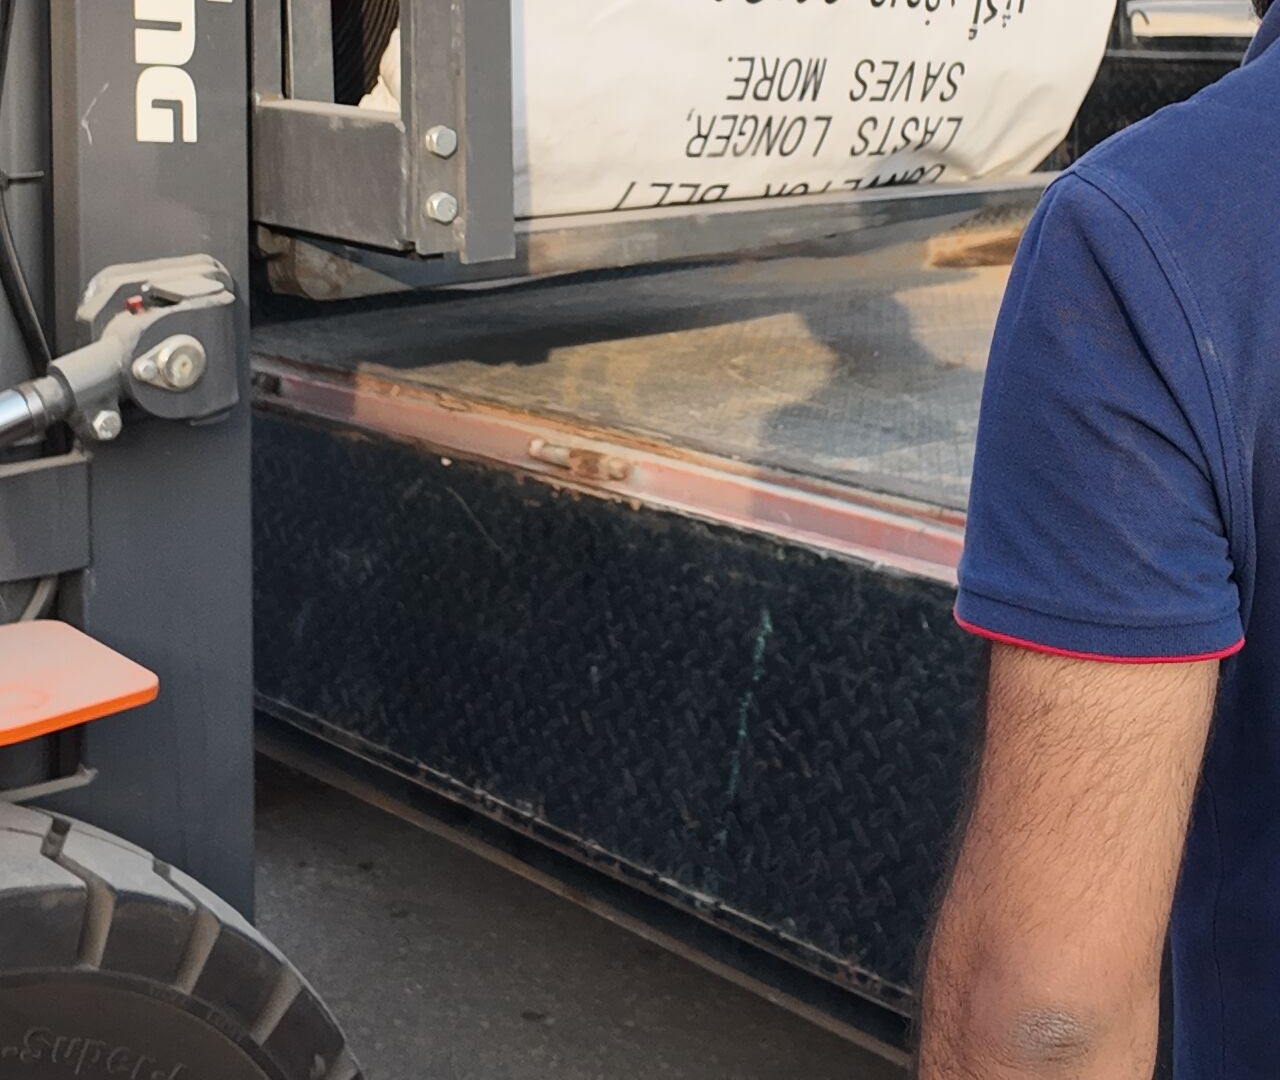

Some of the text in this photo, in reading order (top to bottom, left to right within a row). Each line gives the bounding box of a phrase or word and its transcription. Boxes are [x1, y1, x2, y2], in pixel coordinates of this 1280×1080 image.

[725, 56, 966, 103] SAVES MORE.
[686, 108, 965, 159] LASTS LONGER,
